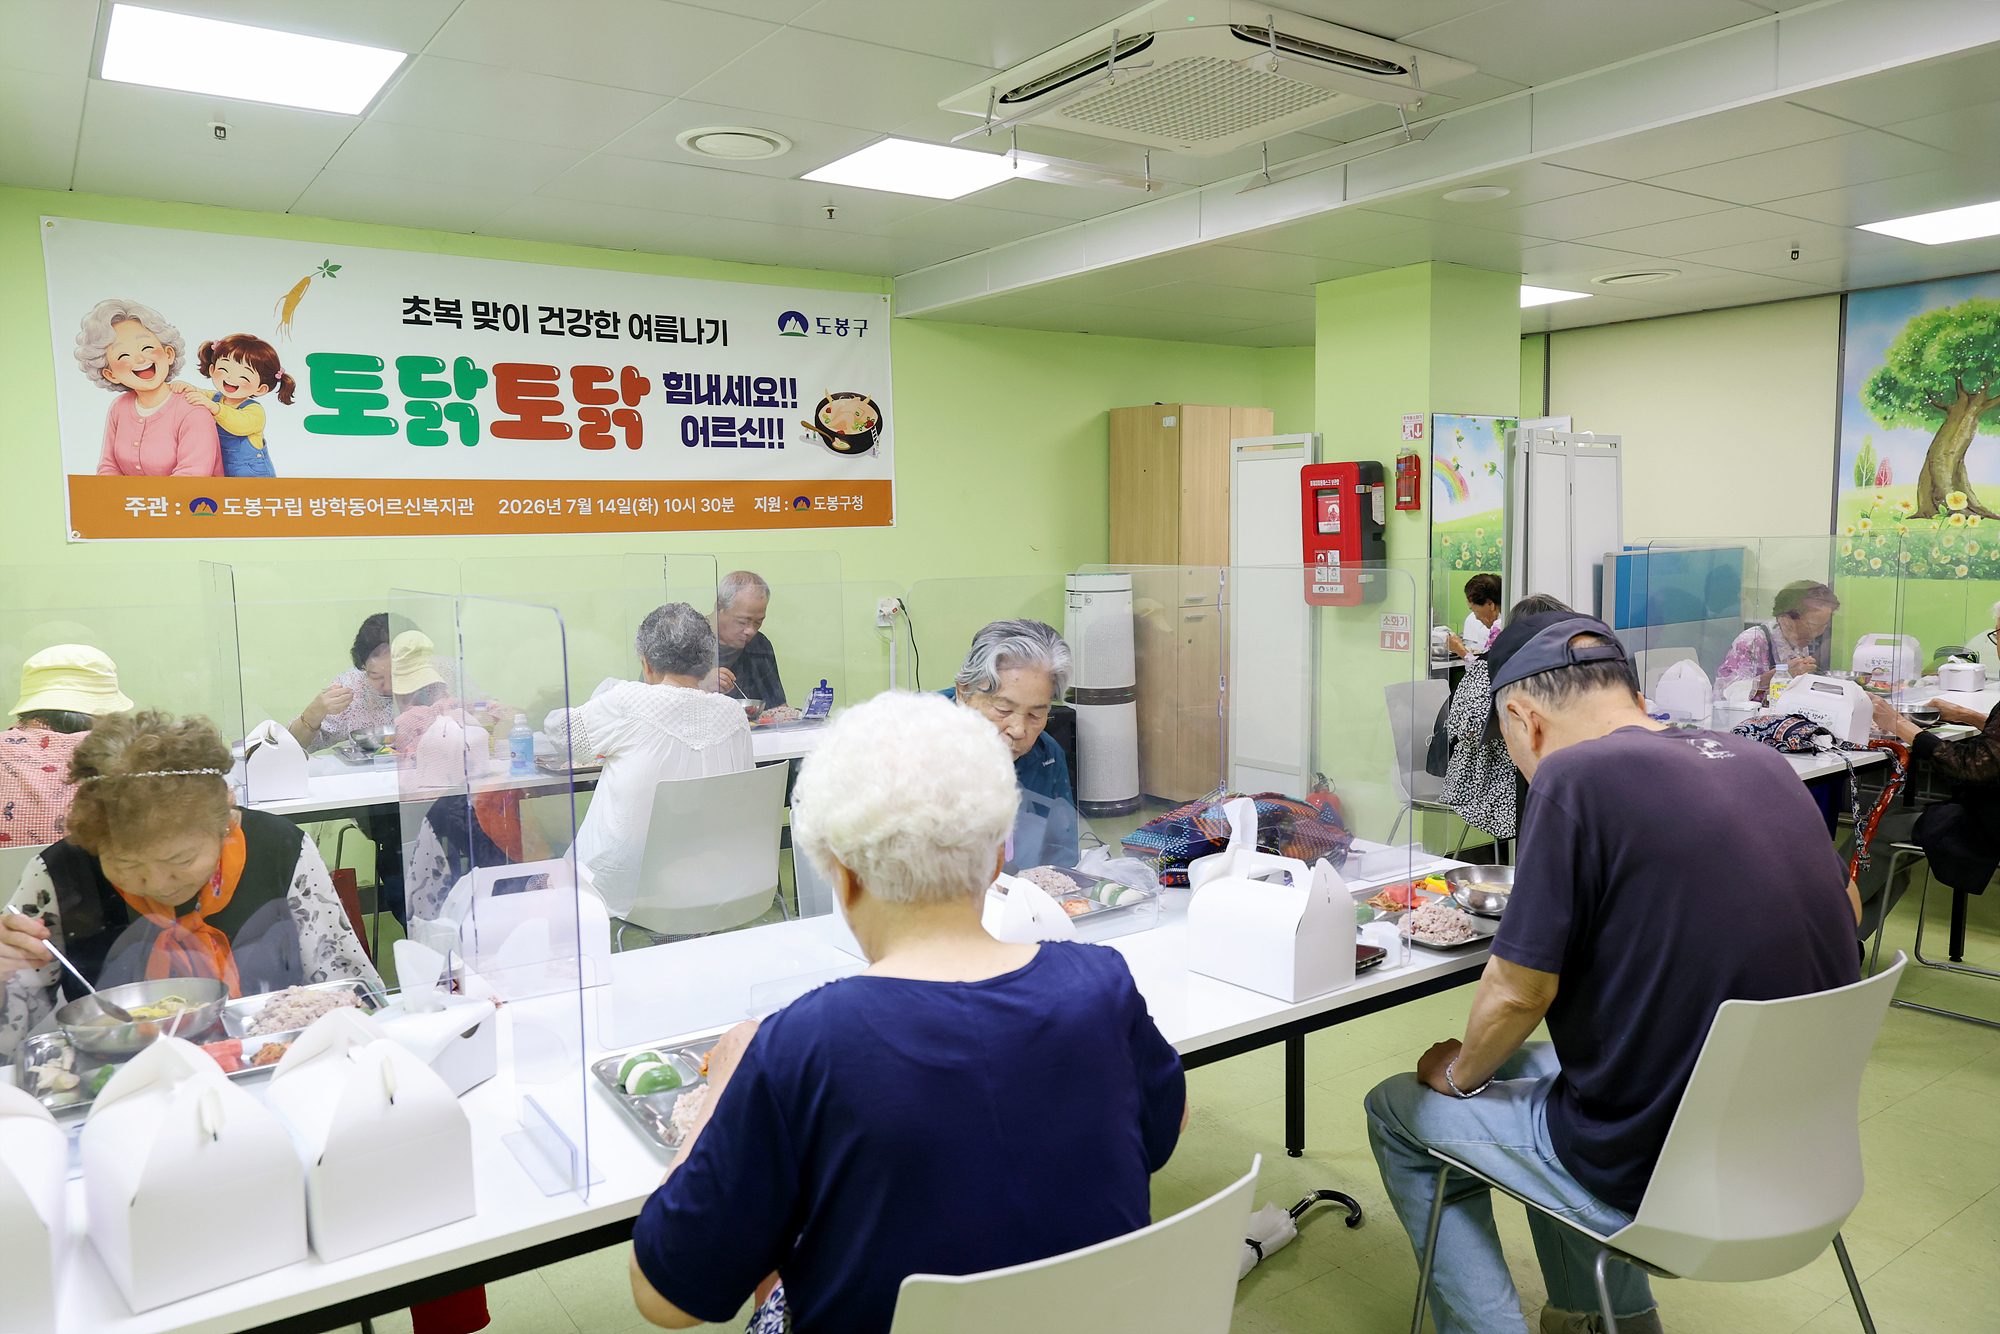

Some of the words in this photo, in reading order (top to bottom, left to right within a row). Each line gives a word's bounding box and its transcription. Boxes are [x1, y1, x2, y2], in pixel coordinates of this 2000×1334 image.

[402, 295, 463, 330] 초복
[471, 300, 530, 334] 맞이
[537, 305, 621, 340] 건강한
[628, 313, 729, 347] 여름나기
[815, 316, 869, 338] 도봉구
[662, 371, 798, 409] 힘내세요!!
[303, 352, 651, 451] 토닭토닭
[681, 415, 785, 450] 어르신!!
[124, 496, 168, 518] 주관
[222, 497, 304, 518] 도봉구립
[309, 497, 475, 518] 방학동어르신복지관
[498, 498, 563, 516] 2026년
[566, 497, 592, 515] 7월
[596, 496, 660, 517] 14일(화)
[664, 496, 696, 514] 10시
[701, 496, 736, 514] 30분
[754, 495, 781, 513] 지원
[813, 495, 864, 512] 도봉구청
[1382, 615, 1408, 627] 소화기
